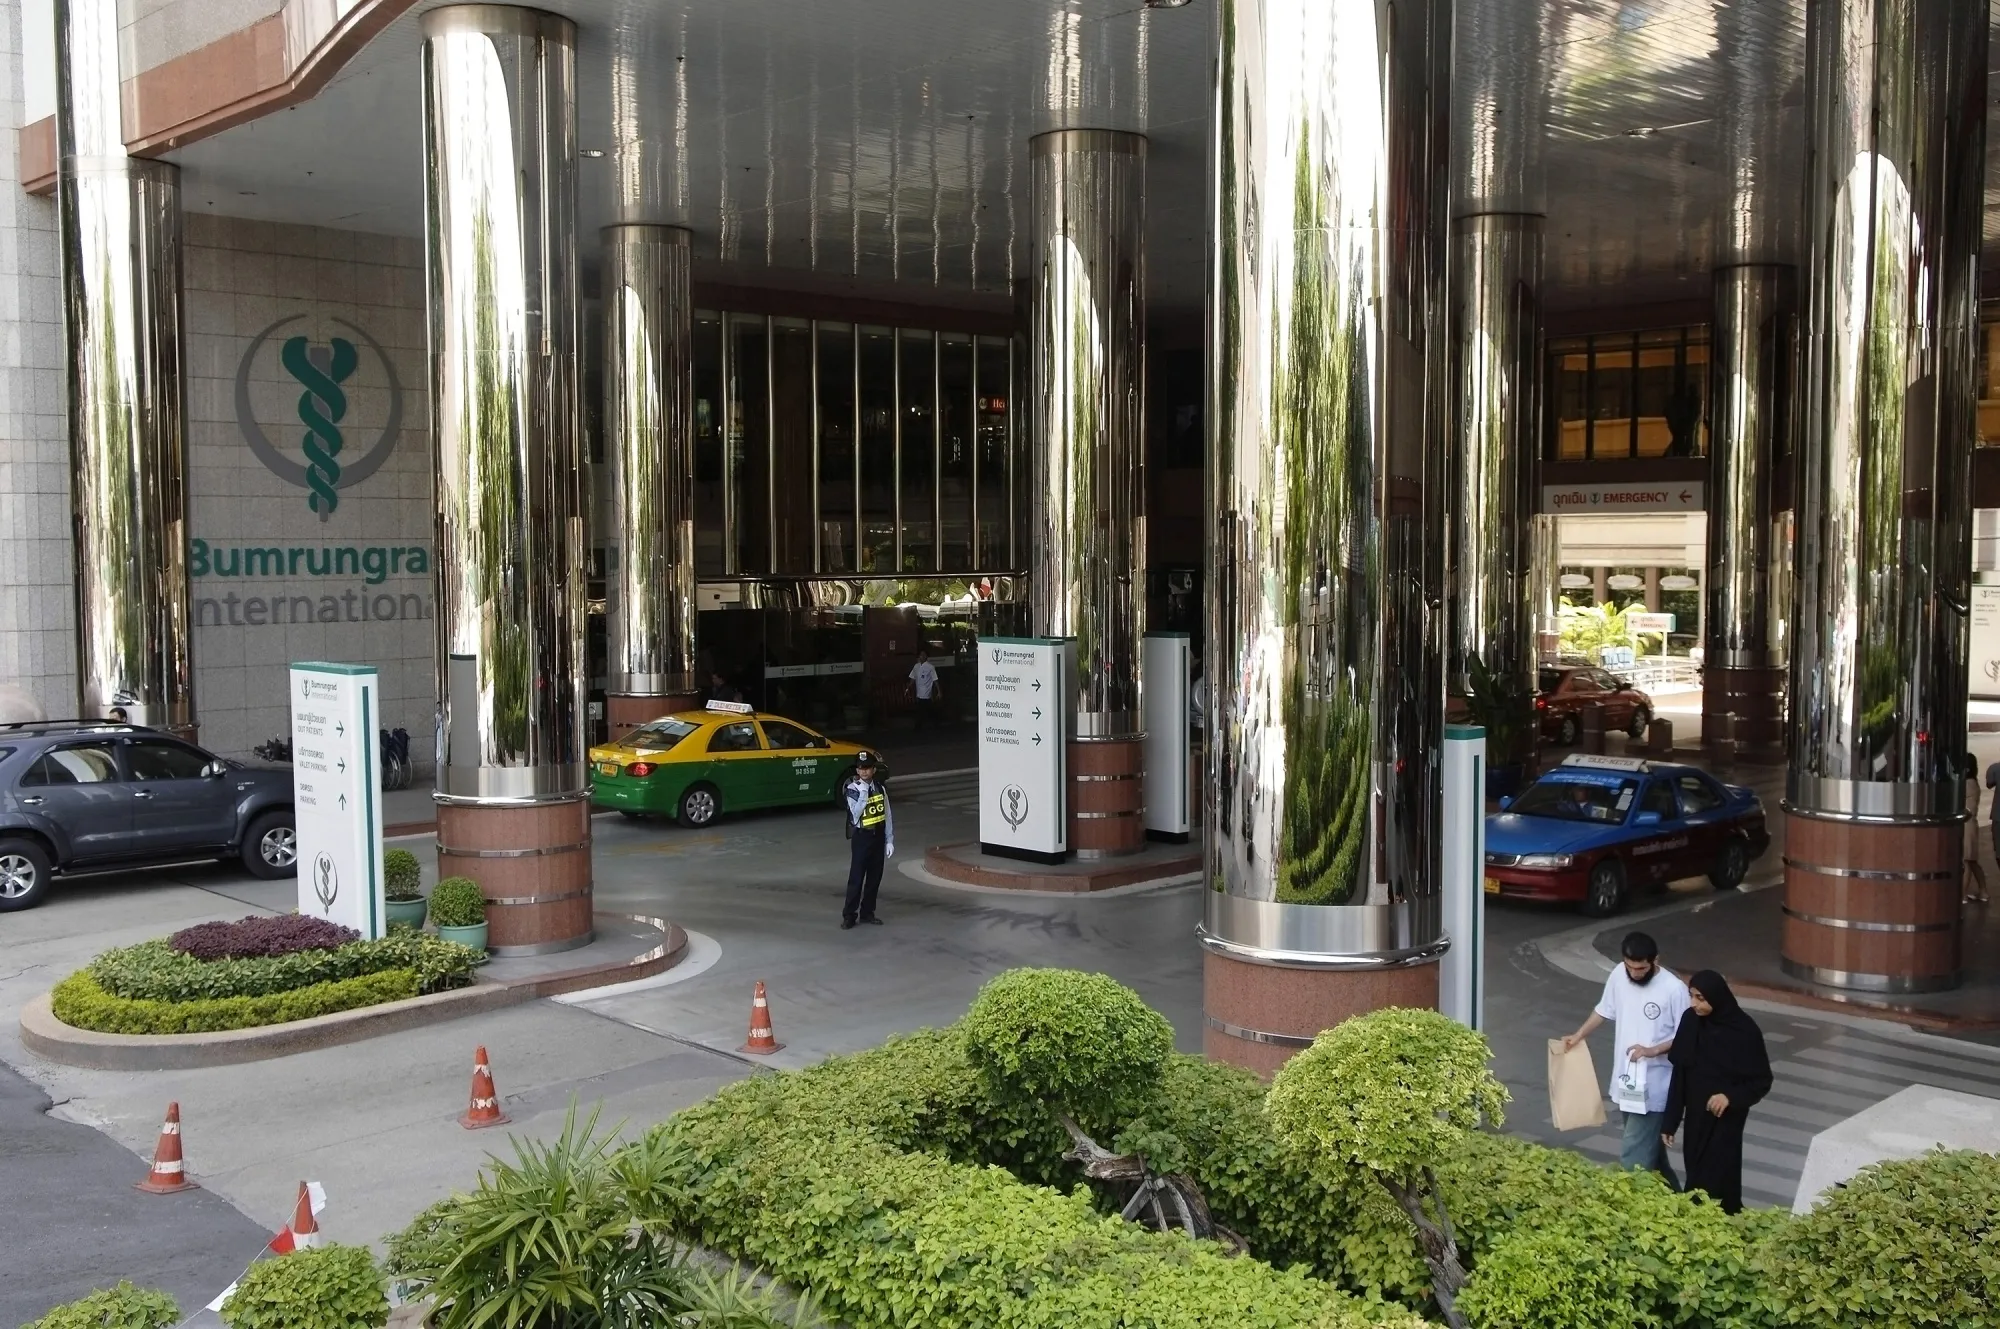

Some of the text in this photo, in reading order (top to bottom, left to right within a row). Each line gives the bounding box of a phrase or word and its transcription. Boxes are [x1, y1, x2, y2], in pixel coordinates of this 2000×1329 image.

[1553, 492, 1669, 507] ฉุกเฉิน EMERGENCY
[190, 538, 428, 584] Bumrungra
[198, 586, 432, 626] nternation
[1003, 651, 1034, 660] Bumrungrad
[311, 680, 337, 691] Bumrungrad
[297, 725, 323, 737] OUT PATIENTS
[1000, 737, 1020, 746] PARKING
[299, 760, 327, 772] VALET PARKING
[299, 795, 317, 806] PARKING
